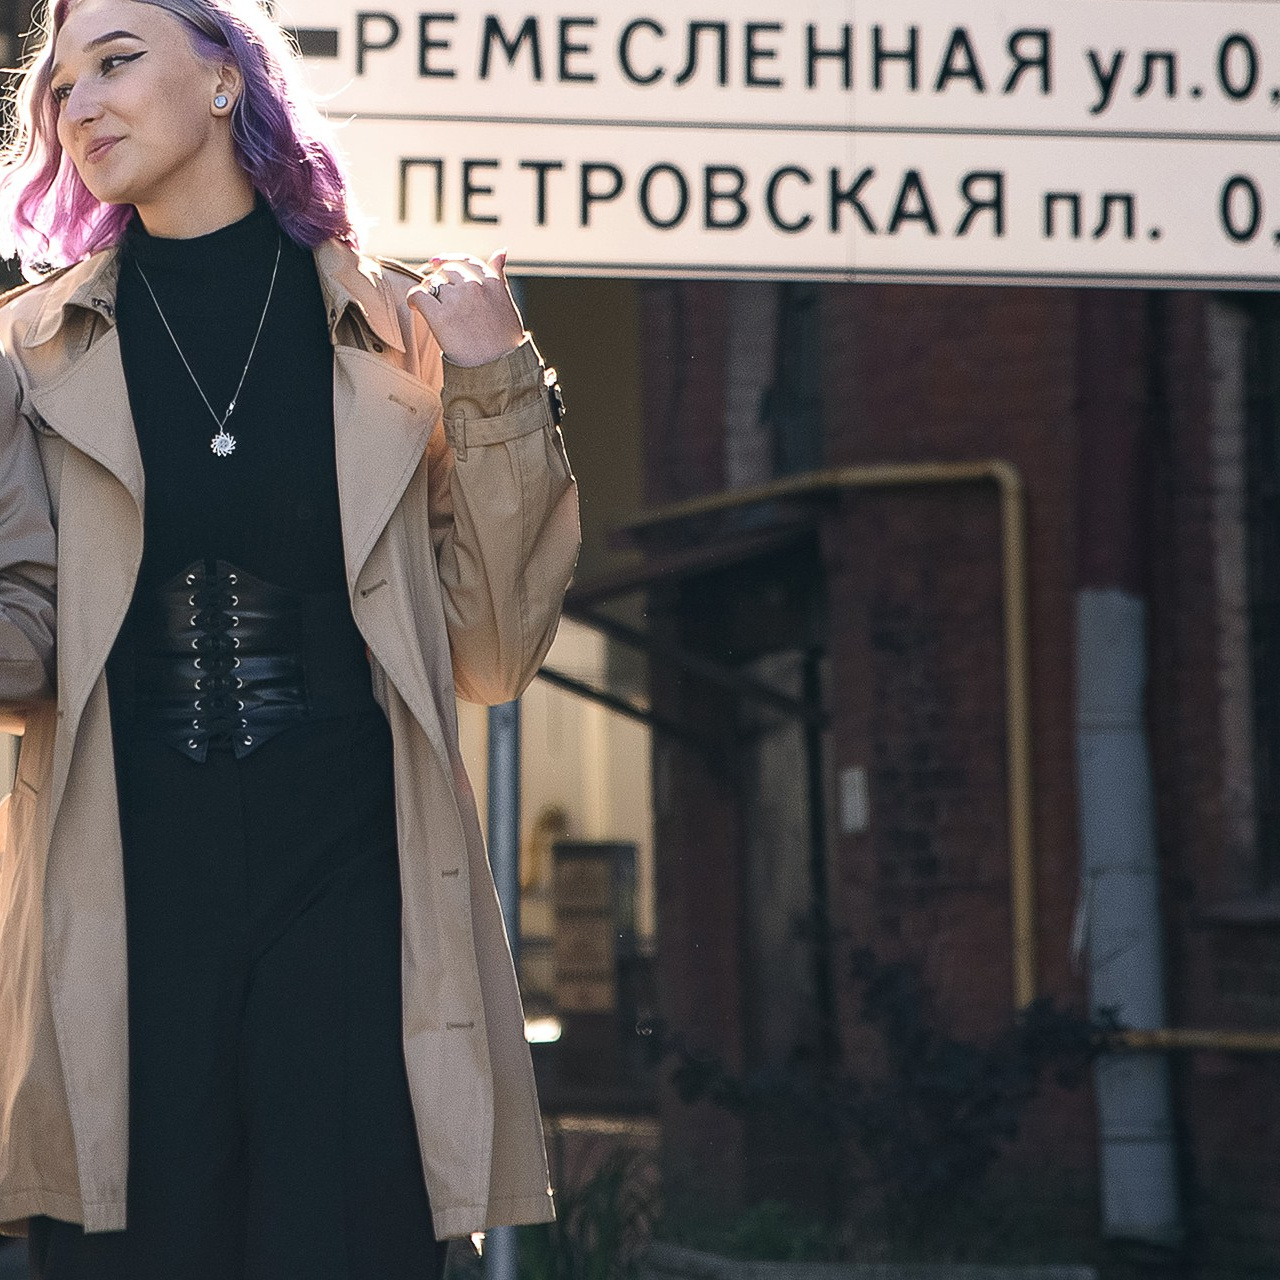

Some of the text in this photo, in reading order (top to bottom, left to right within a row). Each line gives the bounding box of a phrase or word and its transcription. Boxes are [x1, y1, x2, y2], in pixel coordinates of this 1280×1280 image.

[354, 10, 1054, 97] РЕМЕСЛЕННАЯ
[398, 157, 1006, 243] ПЕТРОВСКАЯ
[1041, 190, 1163, 241] пл.
